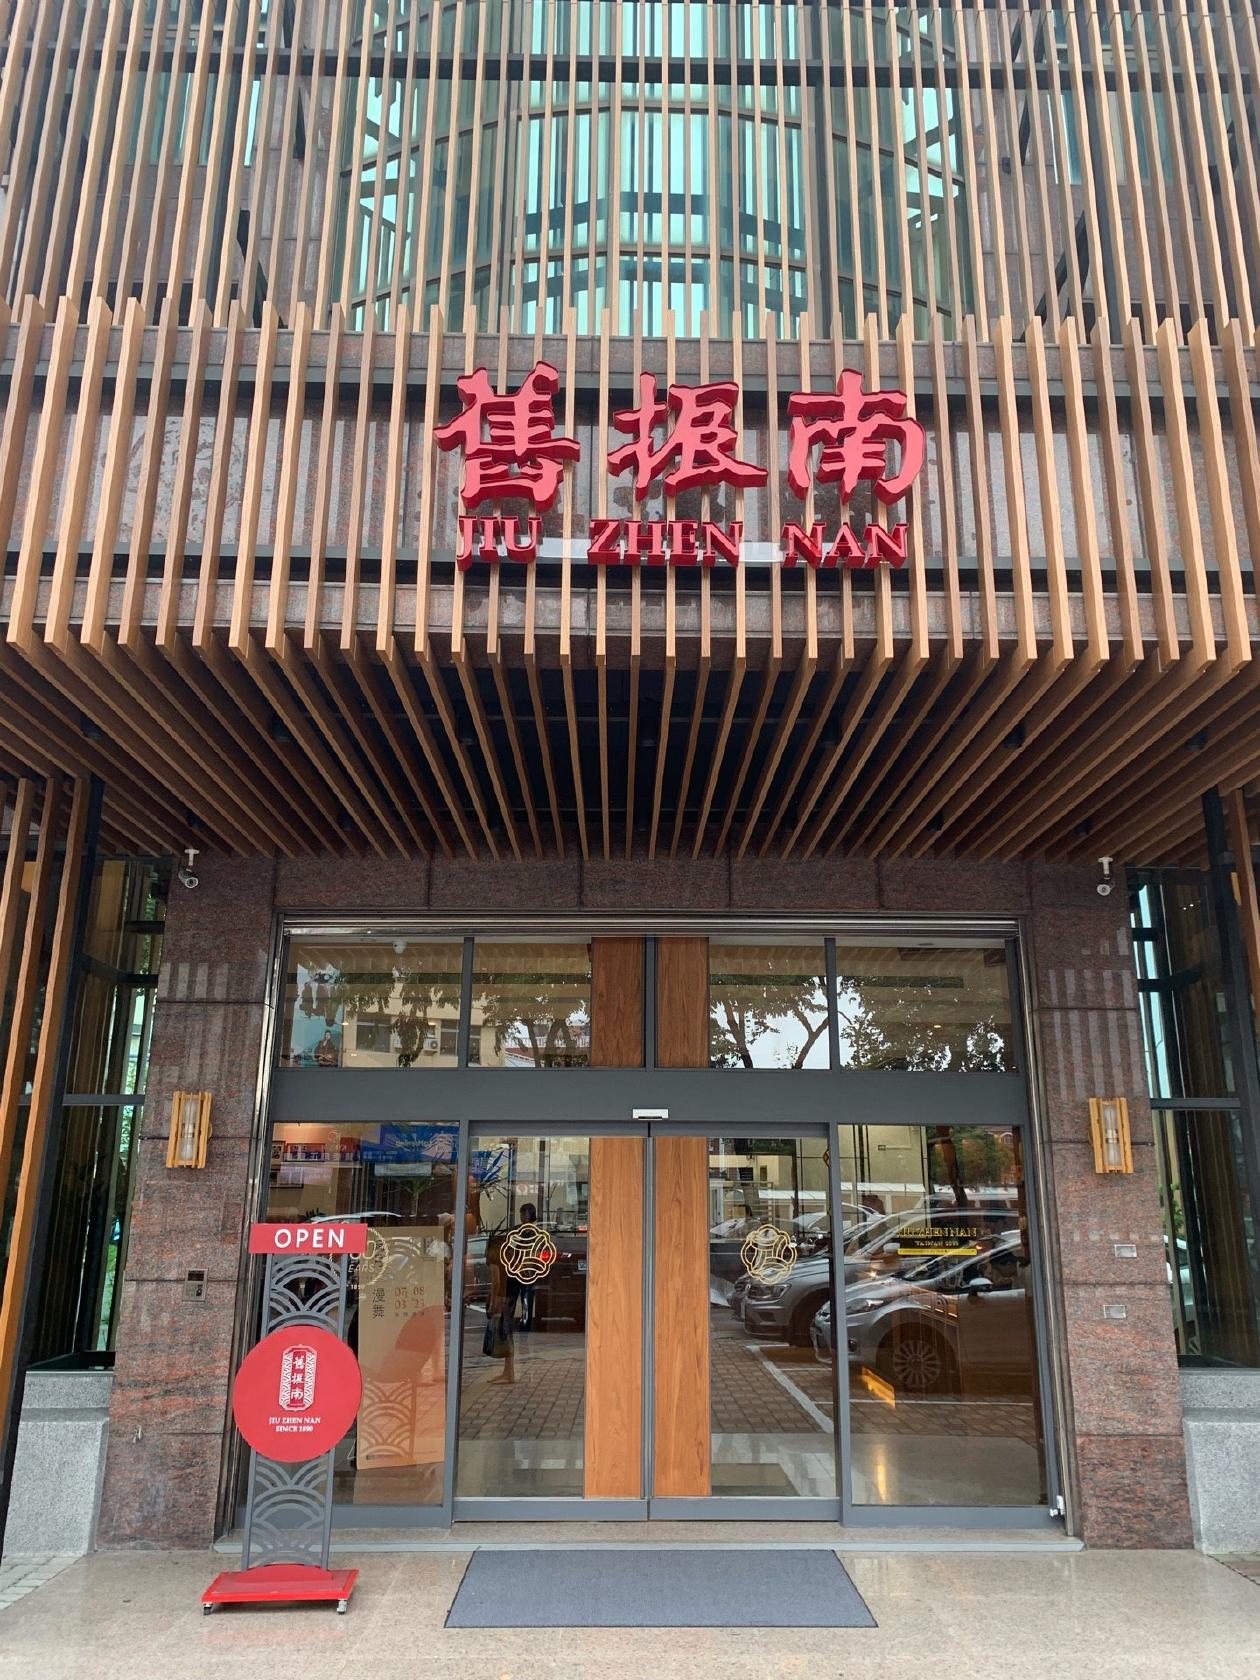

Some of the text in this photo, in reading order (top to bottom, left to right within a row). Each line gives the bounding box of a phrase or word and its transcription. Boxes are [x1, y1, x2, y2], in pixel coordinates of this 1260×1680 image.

[434, 360, 926, 509] 舊振南
[458, 515, 908, 571] JIU ZHEN NAN
[274, 1228, 345, 1249] OPEN
[949, 1227, 977, 1237] NAN
[347, 1263, 375, 1273] EARS
[269, 1417, 281, 1425] JIU
